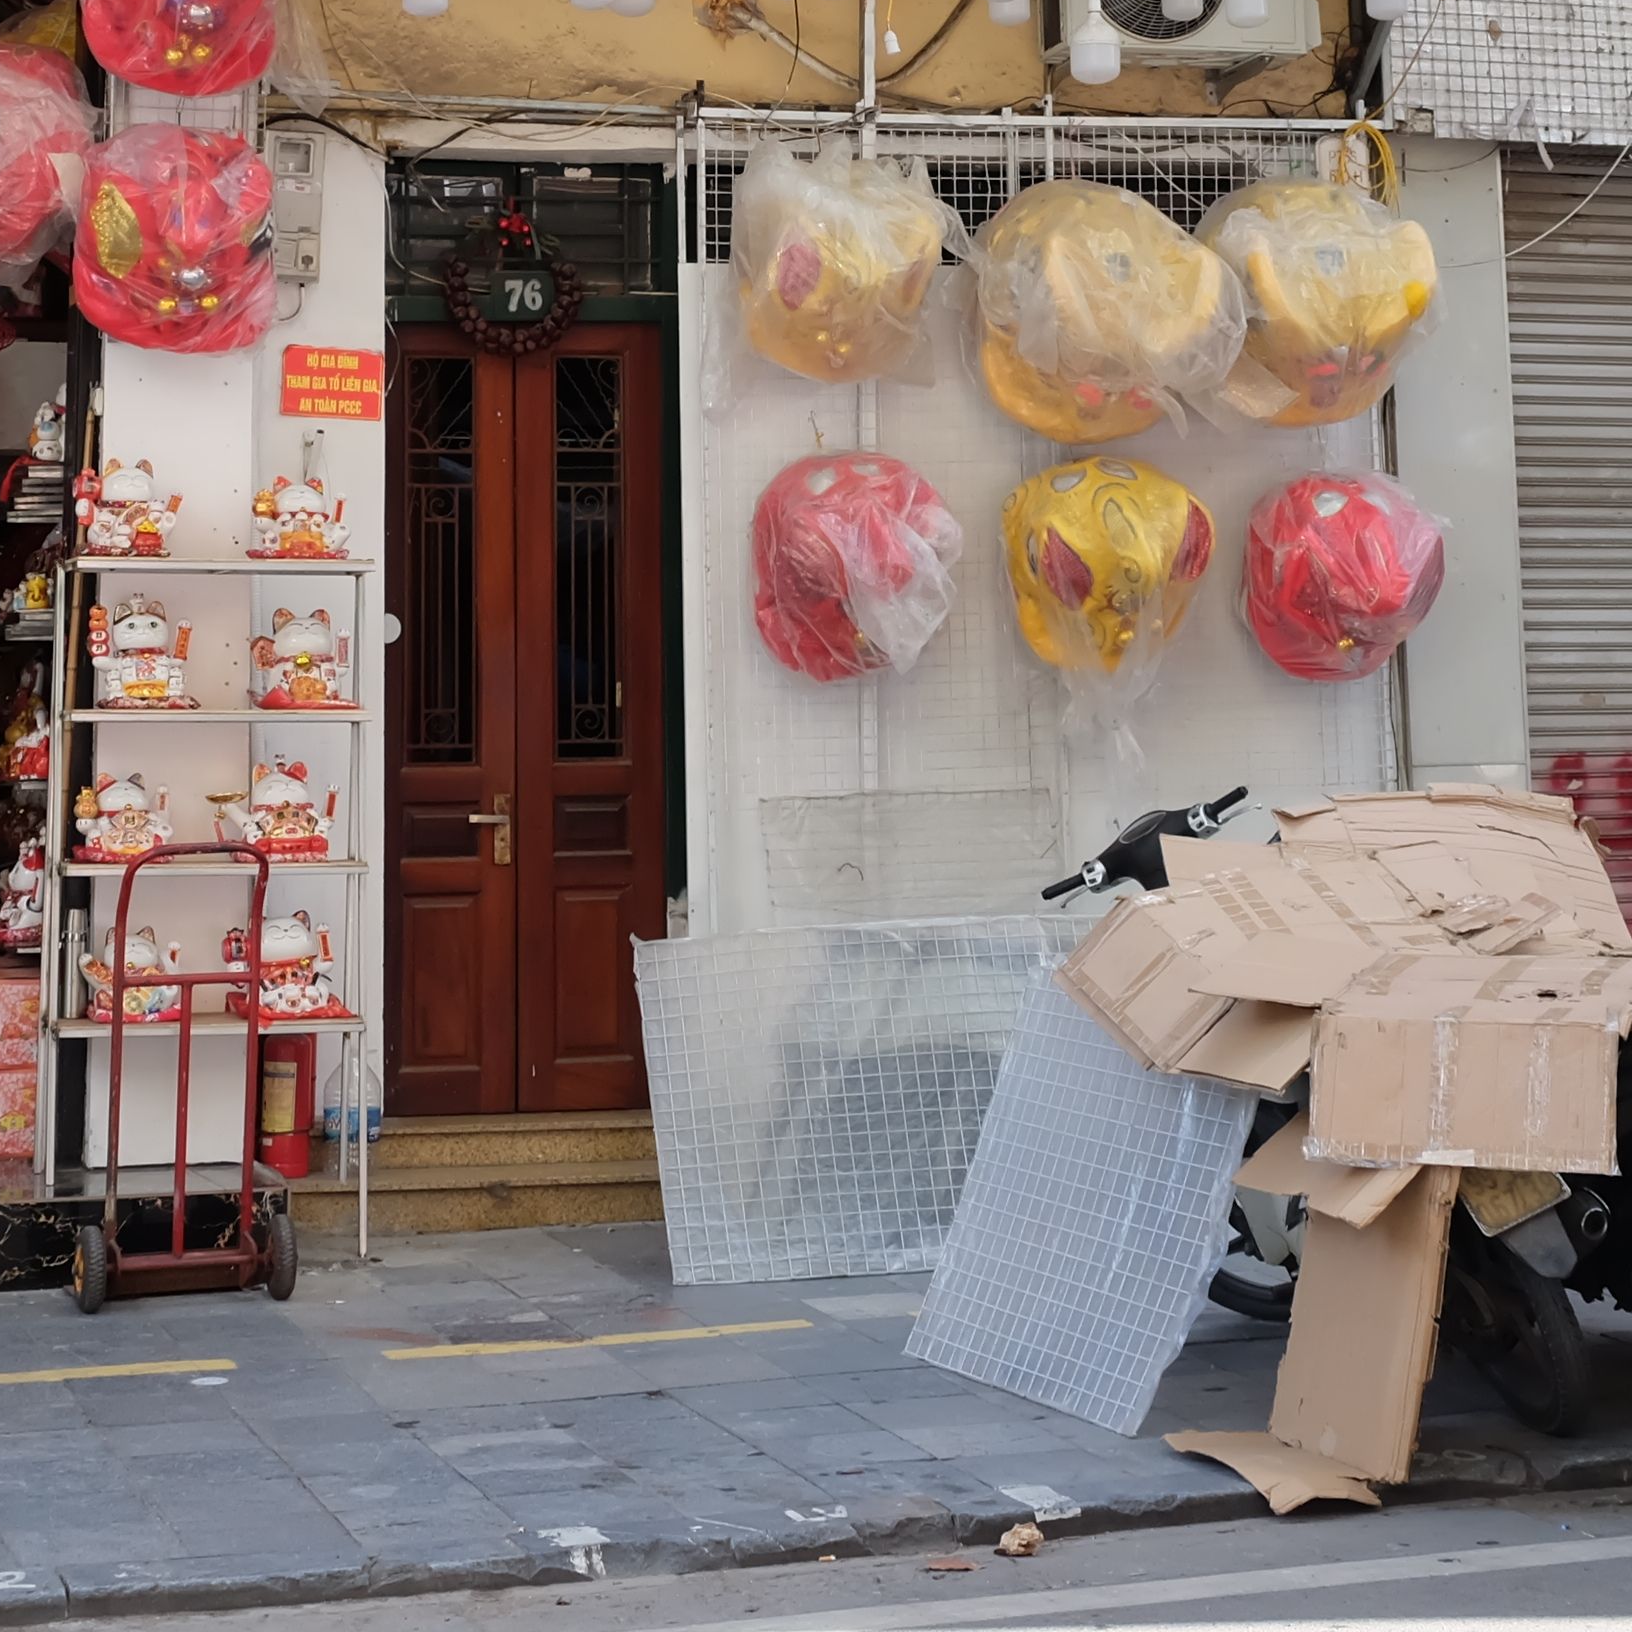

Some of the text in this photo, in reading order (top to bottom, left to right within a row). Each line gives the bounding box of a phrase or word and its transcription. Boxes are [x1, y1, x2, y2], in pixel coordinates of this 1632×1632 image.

[504, 278, 543, 312] 76
[306, 351, 319, 369] HỘ
[321, 355, 336, 368] GIA
[286, 374, 310, 389] THAM
[312, 376, 327, 389] GIA
[299, 396, 362, 415] AN TOÀN PCCC
